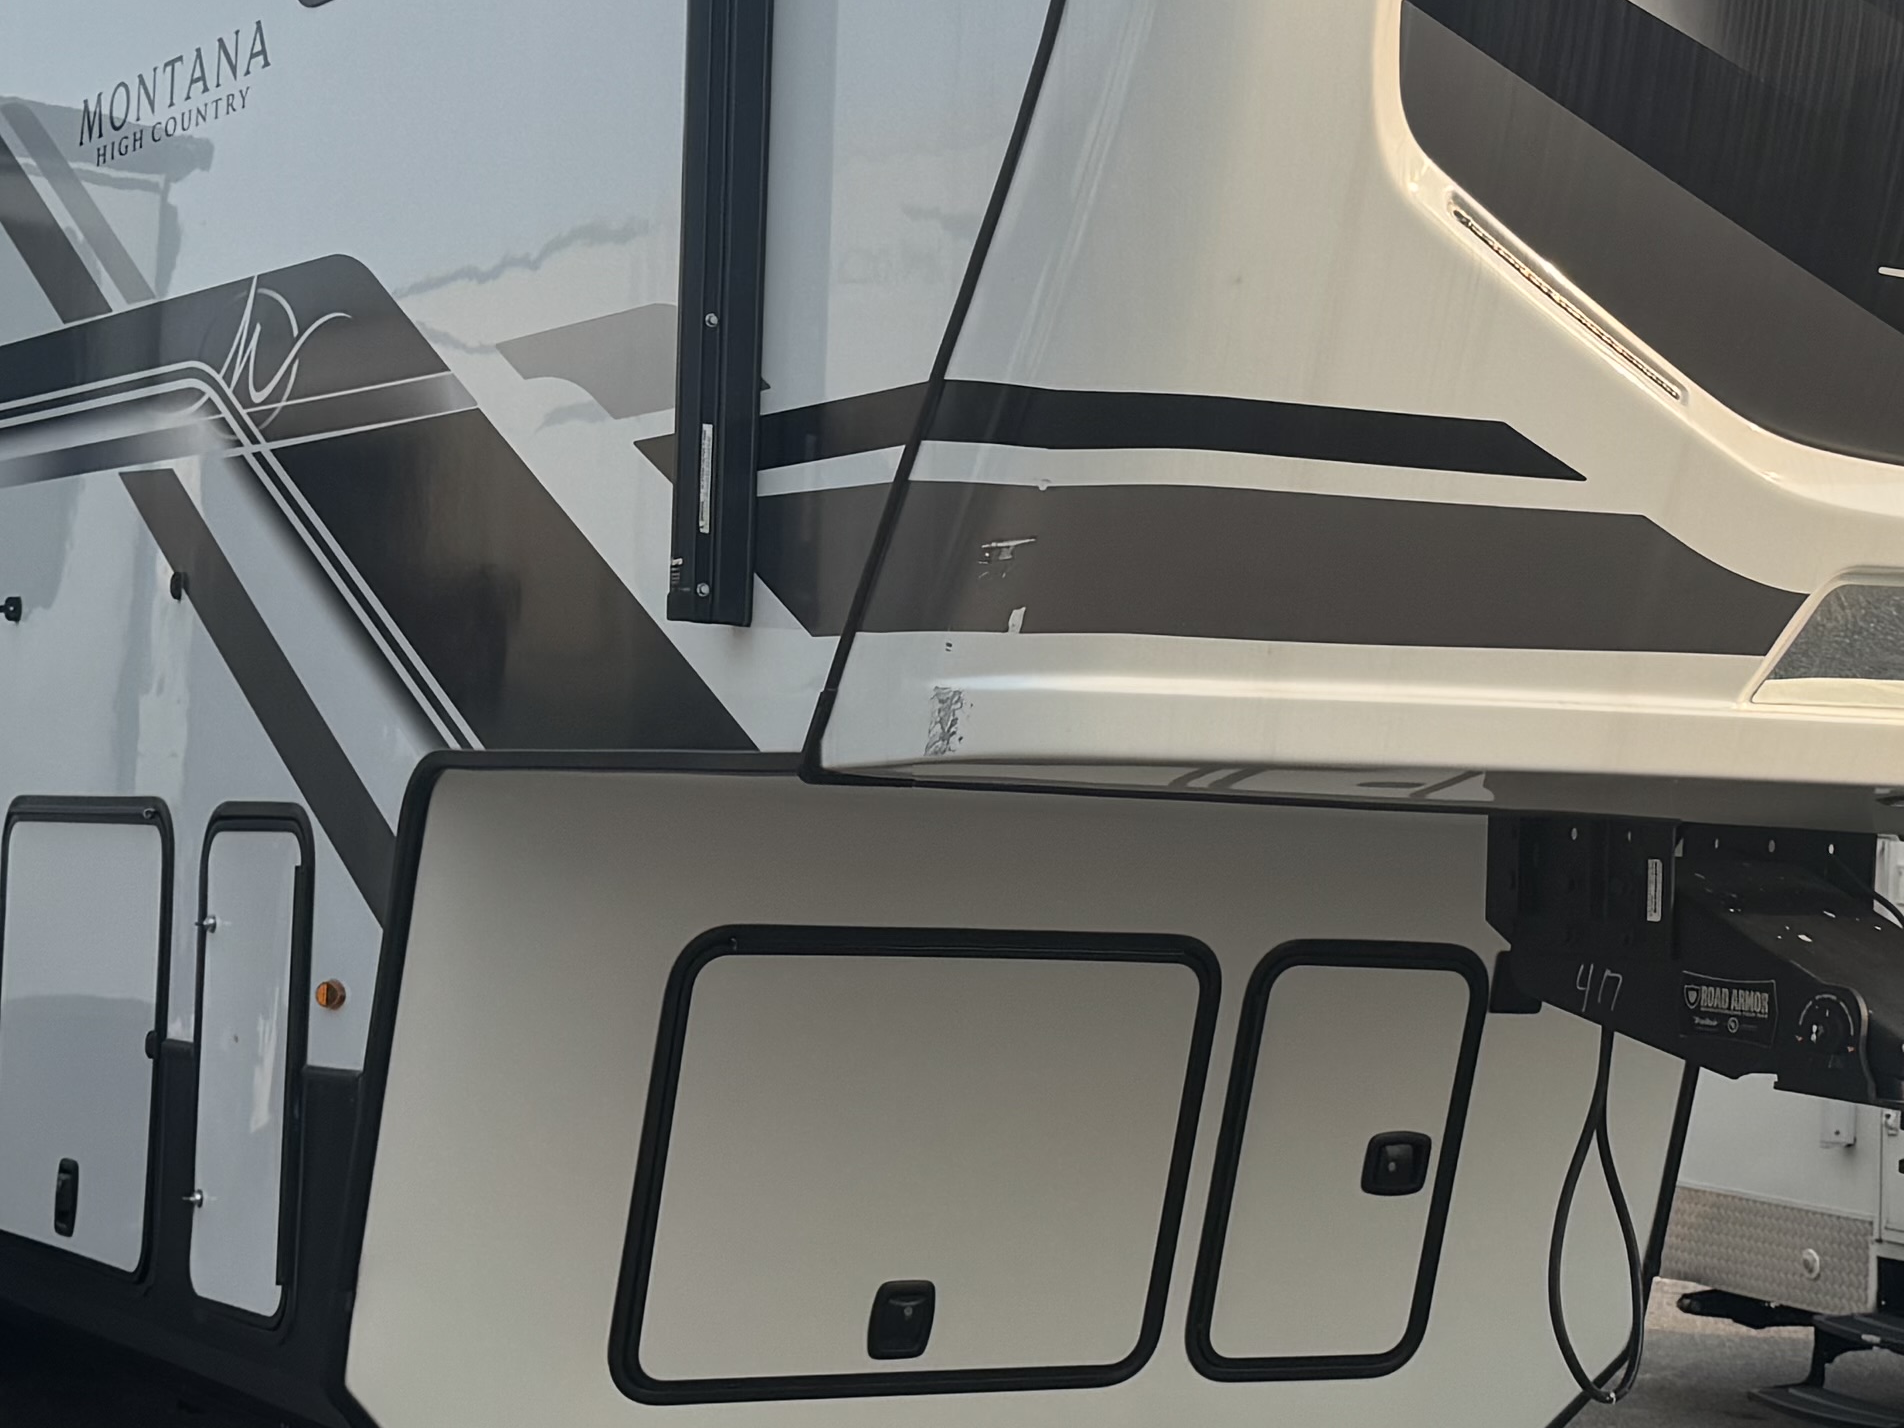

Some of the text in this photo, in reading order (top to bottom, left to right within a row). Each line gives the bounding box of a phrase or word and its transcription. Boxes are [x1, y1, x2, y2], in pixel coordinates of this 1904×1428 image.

[78, 19, 272, 147] MONTANA
[96, 86, 251, 167] HIGH COUNTRY
[1700, 985, 1729, 1009] ROAD
[1730, 988, 1769, 1014] ARMOR
